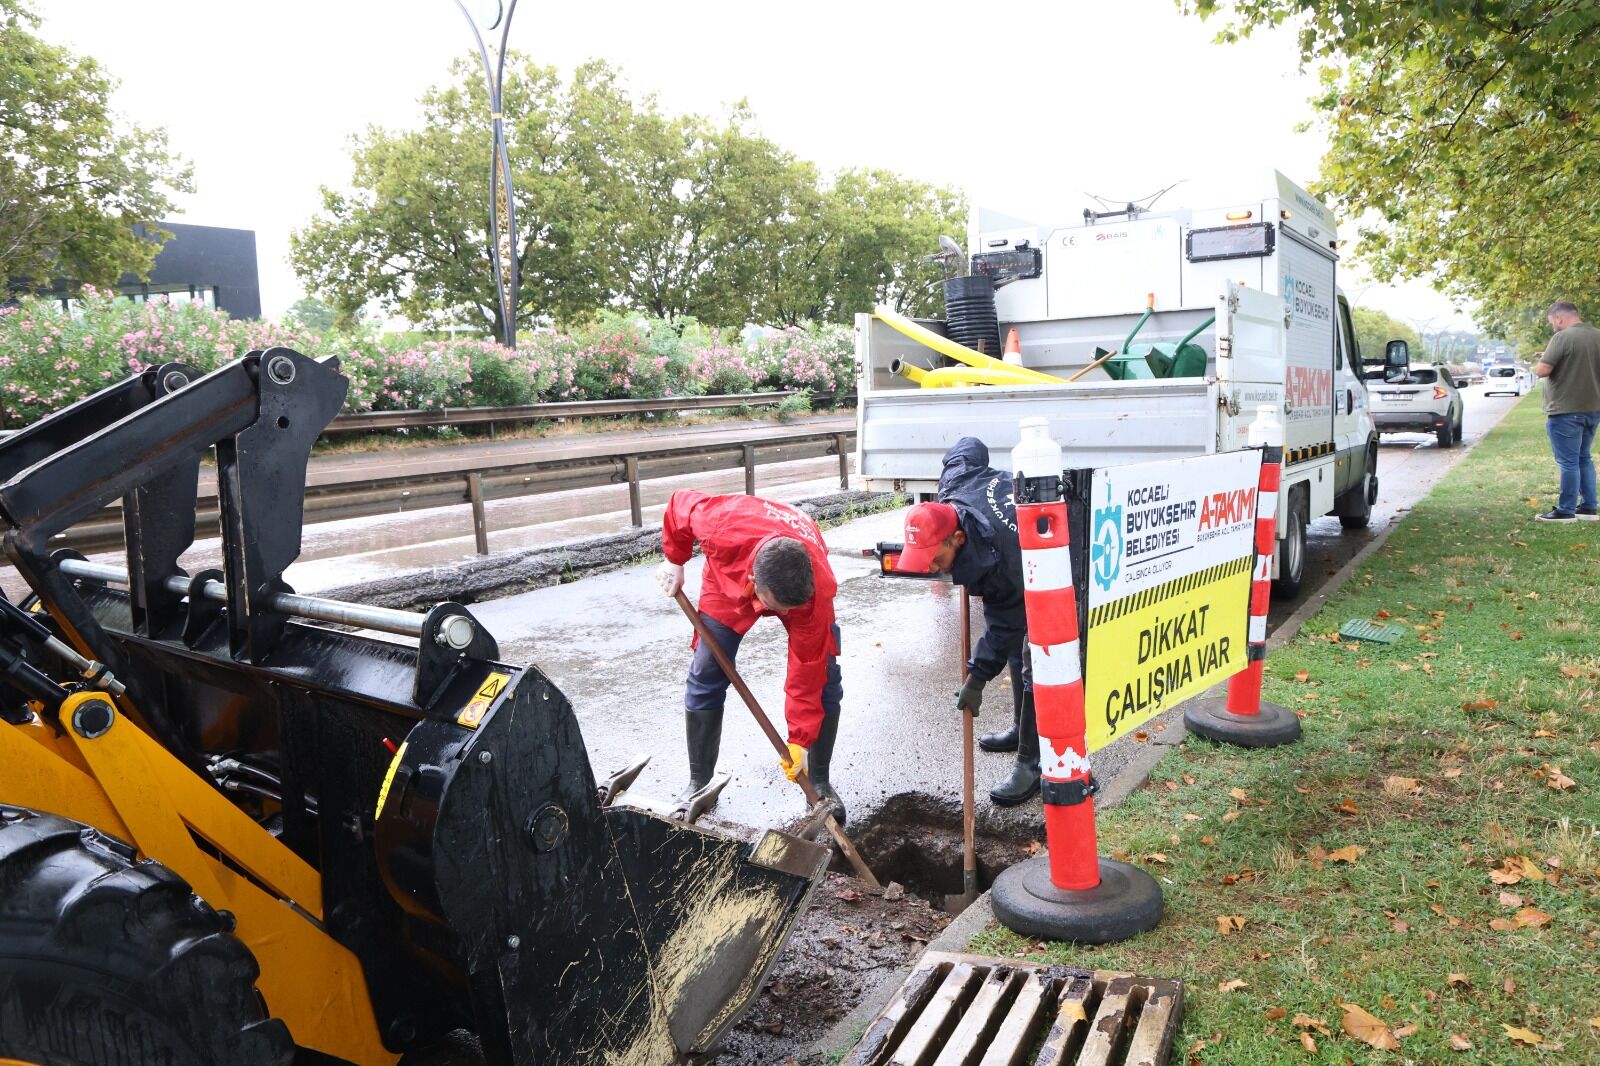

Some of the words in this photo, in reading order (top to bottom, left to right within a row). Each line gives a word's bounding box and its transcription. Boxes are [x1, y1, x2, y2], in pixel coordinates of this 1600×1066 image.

[986, 477, 1018, 532] ÜYÜKŞEHİR
[1126, 500, 1197, 535] BÜYÜKŞEHİR
[1127, 483, 1170, 508] KOCAELİ
[1198, 487, 1256, 532] A-TAKIMI
[1125, 528, 1180, 558] BELEDİYESİ
[1137, 604, 1209, 665] DİKKAT
[1105, 654, 1192, 736] ÇALIŞMA
[1197, 636, 1230, 677] VAR
